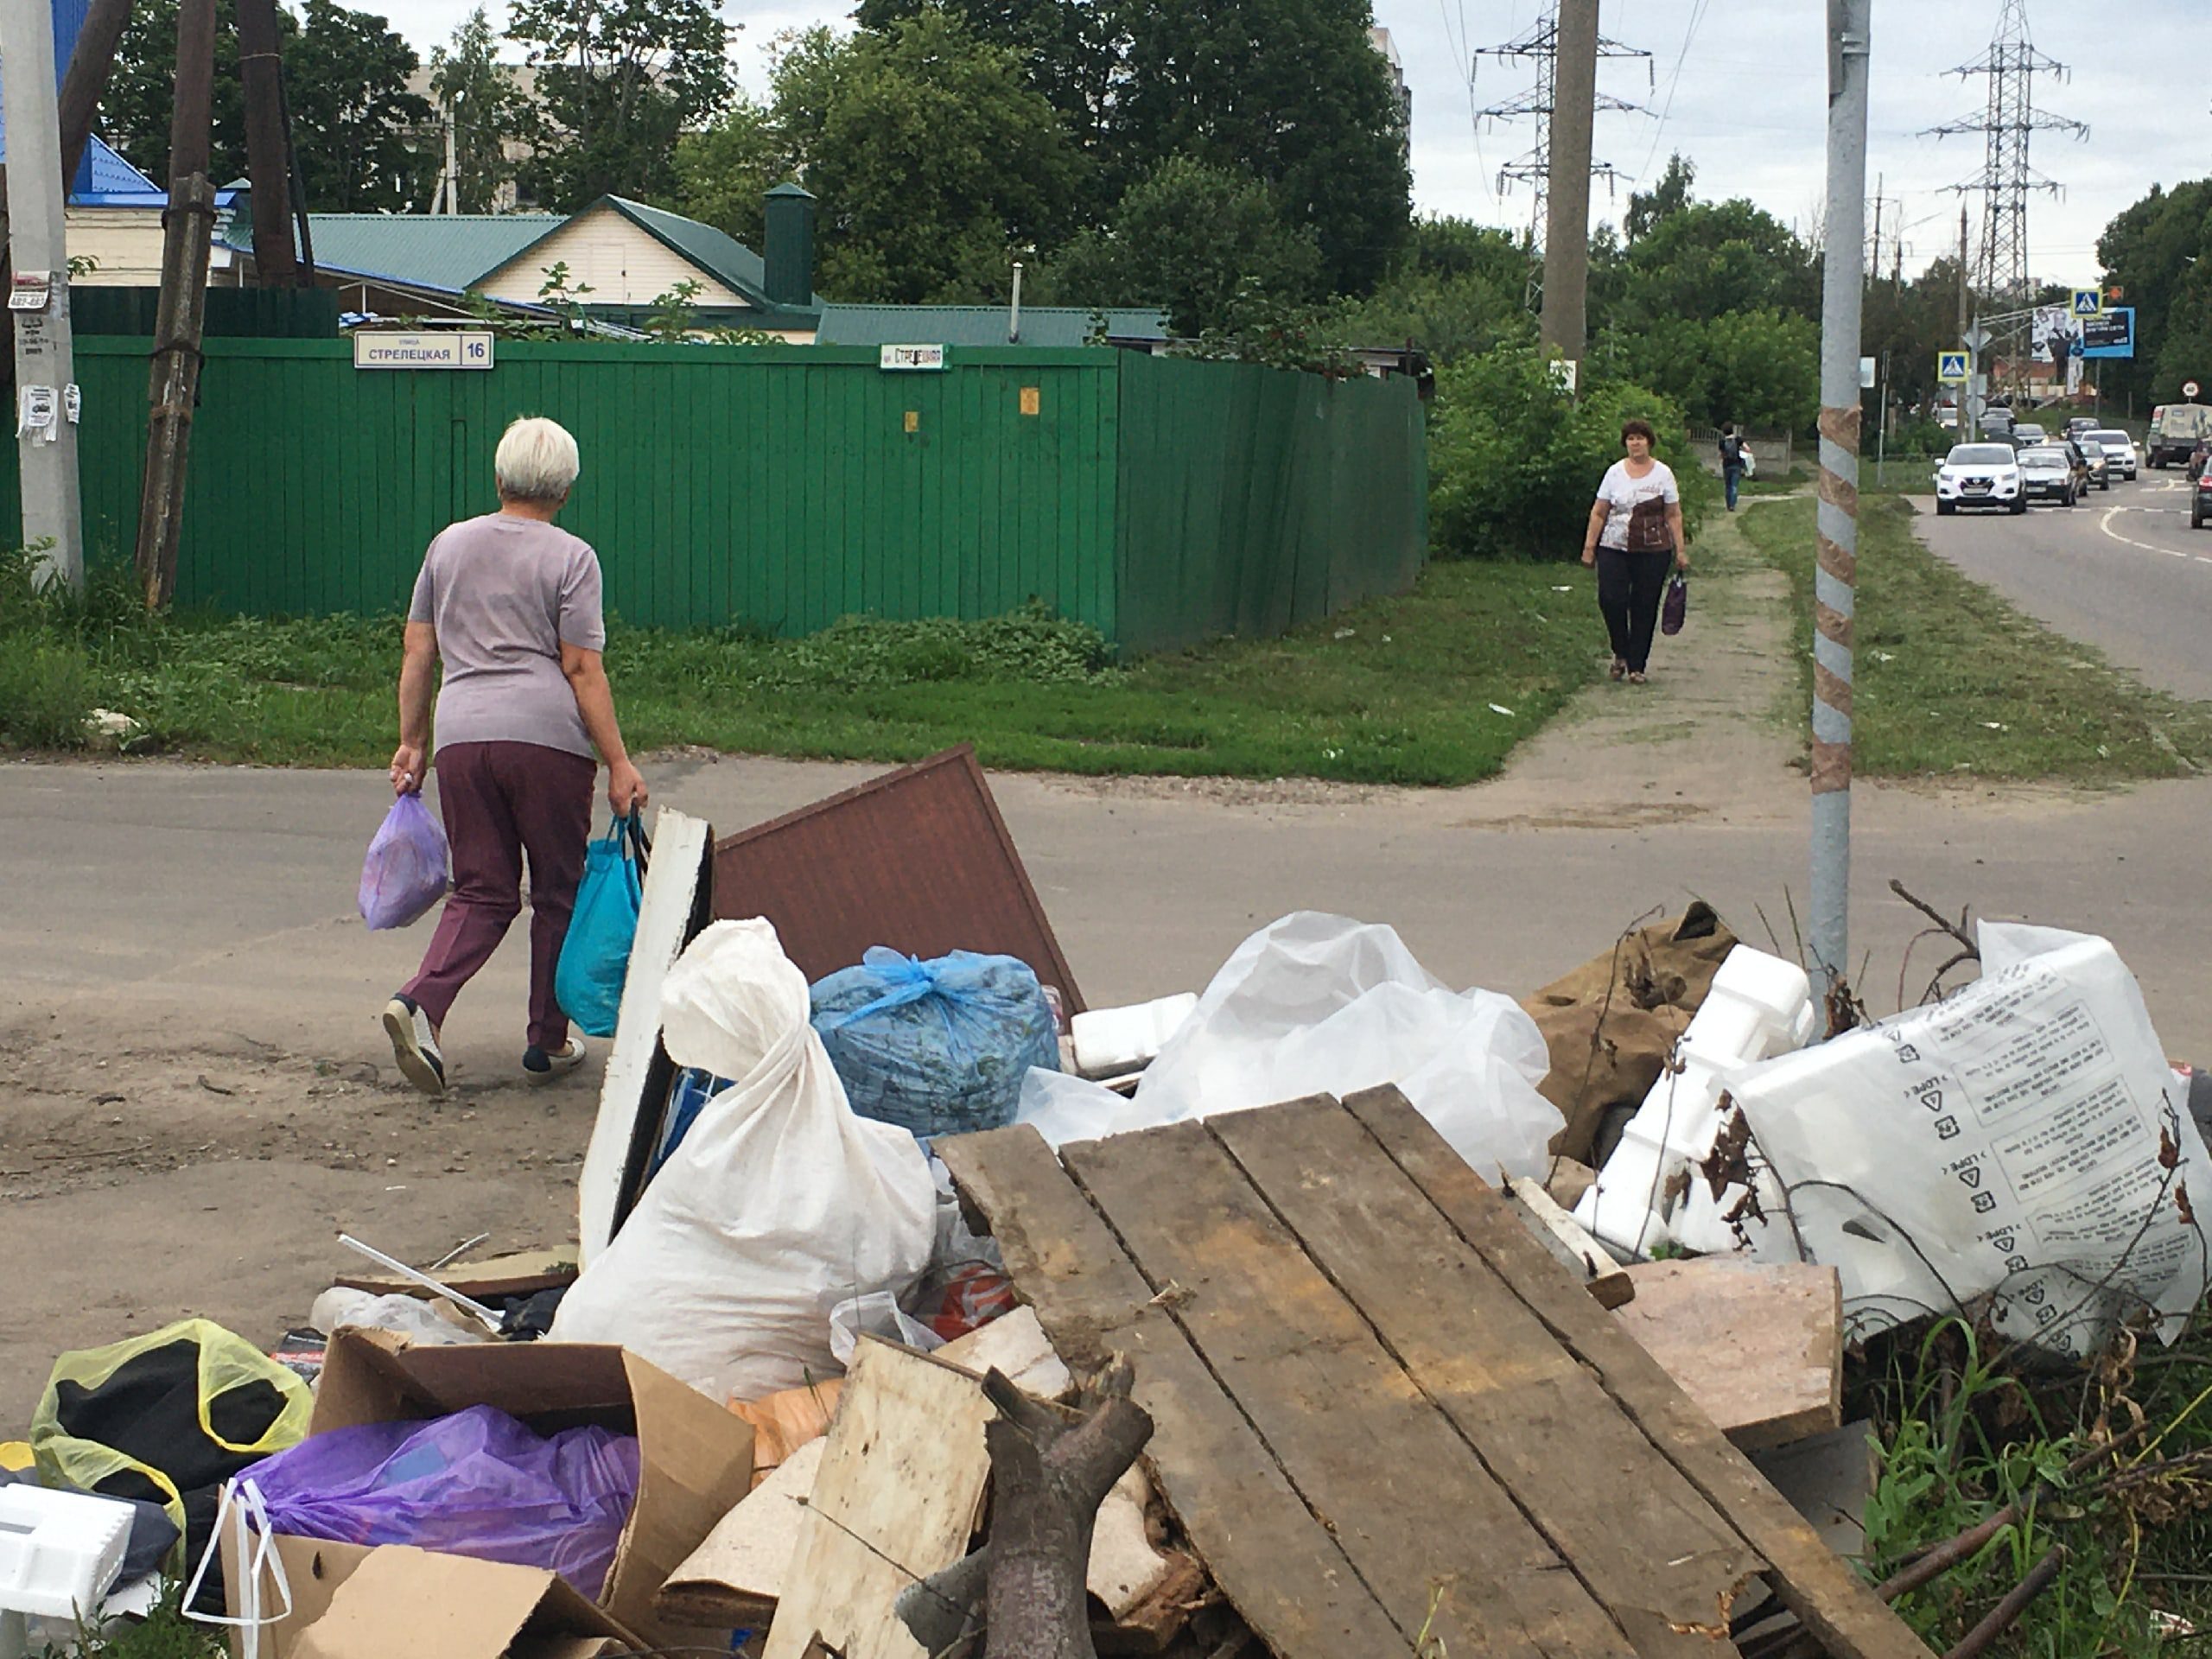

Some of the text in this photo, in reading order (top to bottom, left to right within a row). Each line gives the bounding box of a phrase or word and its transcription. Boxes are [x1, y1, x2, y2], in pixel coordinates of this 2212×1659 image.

[368, 348, 451, 360] СТРЕЛЕЦКАЯ
[467, 342, 485, 358] 16
[895, 348, 941, 364] СТРЕЕЦКАЯ
